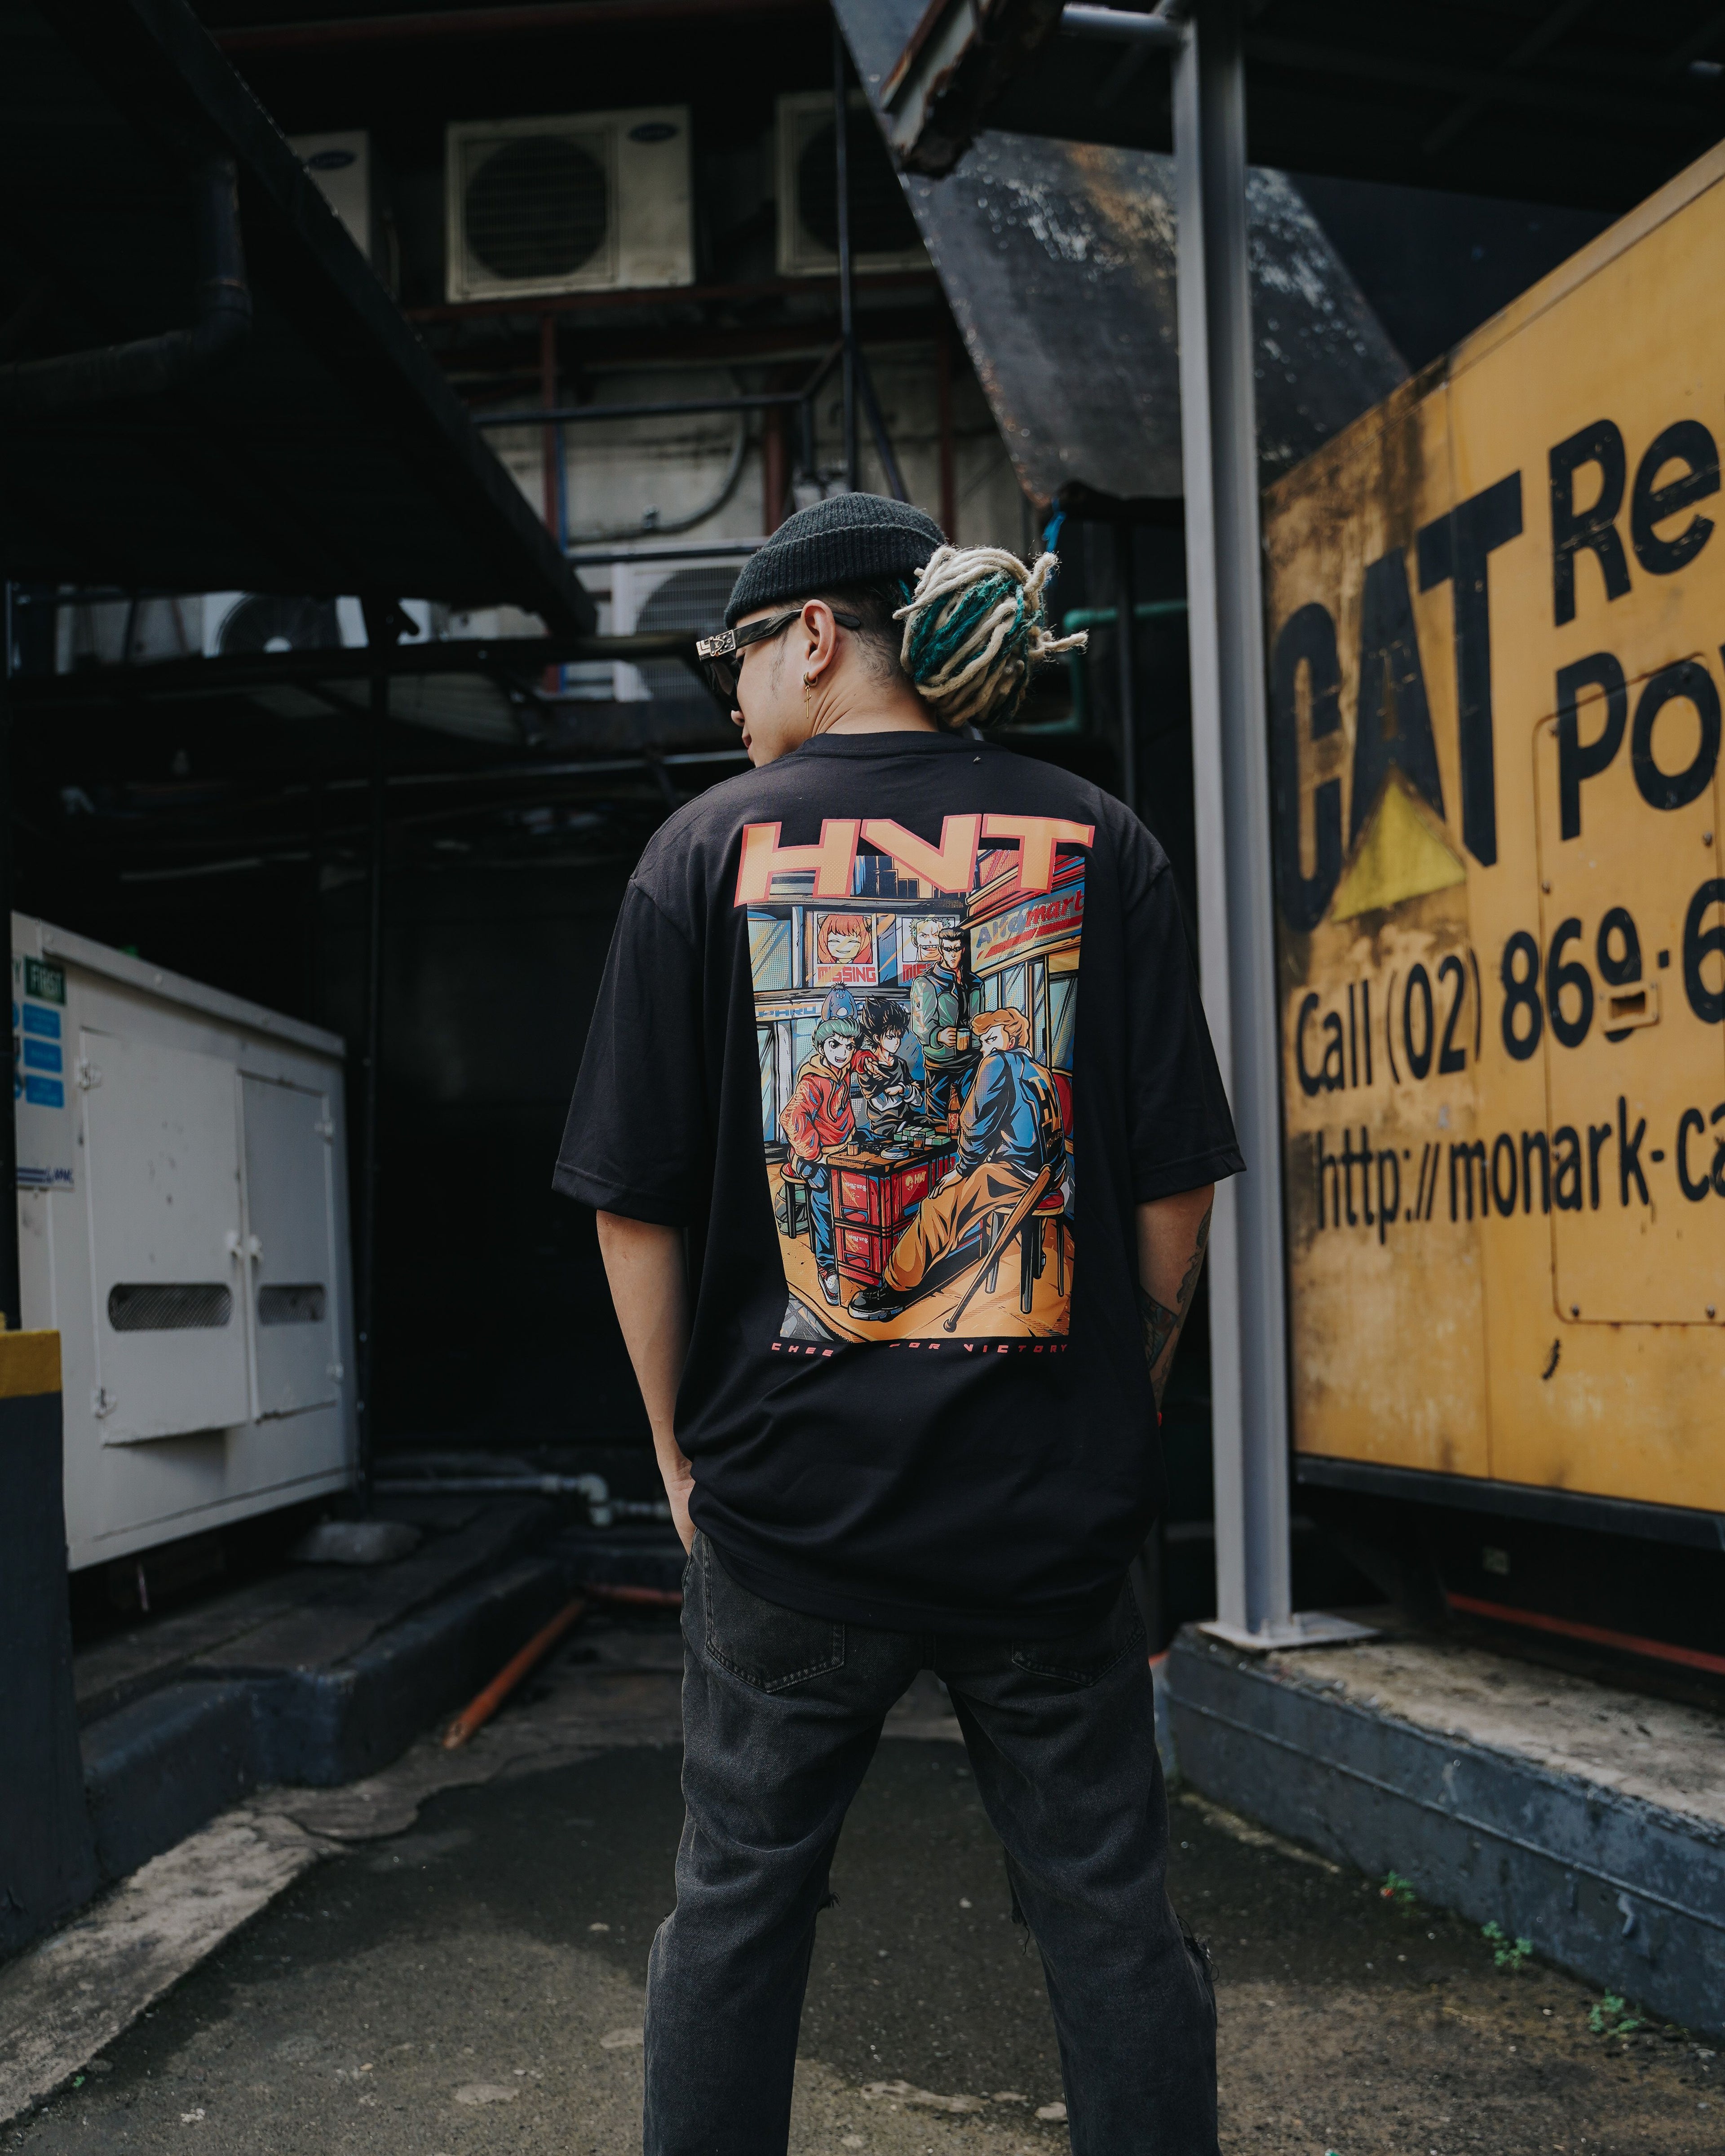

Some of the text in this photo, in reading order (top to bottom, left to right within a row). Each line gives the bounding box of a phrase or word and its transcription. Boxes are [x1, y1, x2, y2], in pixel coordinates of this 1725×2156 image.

[1548, 419, 1721, 627] Re
[1272, 469, 1523, 933] CAT
[1555, 644, 1725, 841] Po
[734, 813, 1095, 908] HNT
[1296, 978, 1372, 1096] Call
[1387, 946, 1482, 1085] (02)
[771, 1342, 834, 1357] CHEE
[963, 1343, 1067, 1353] VICTORY
